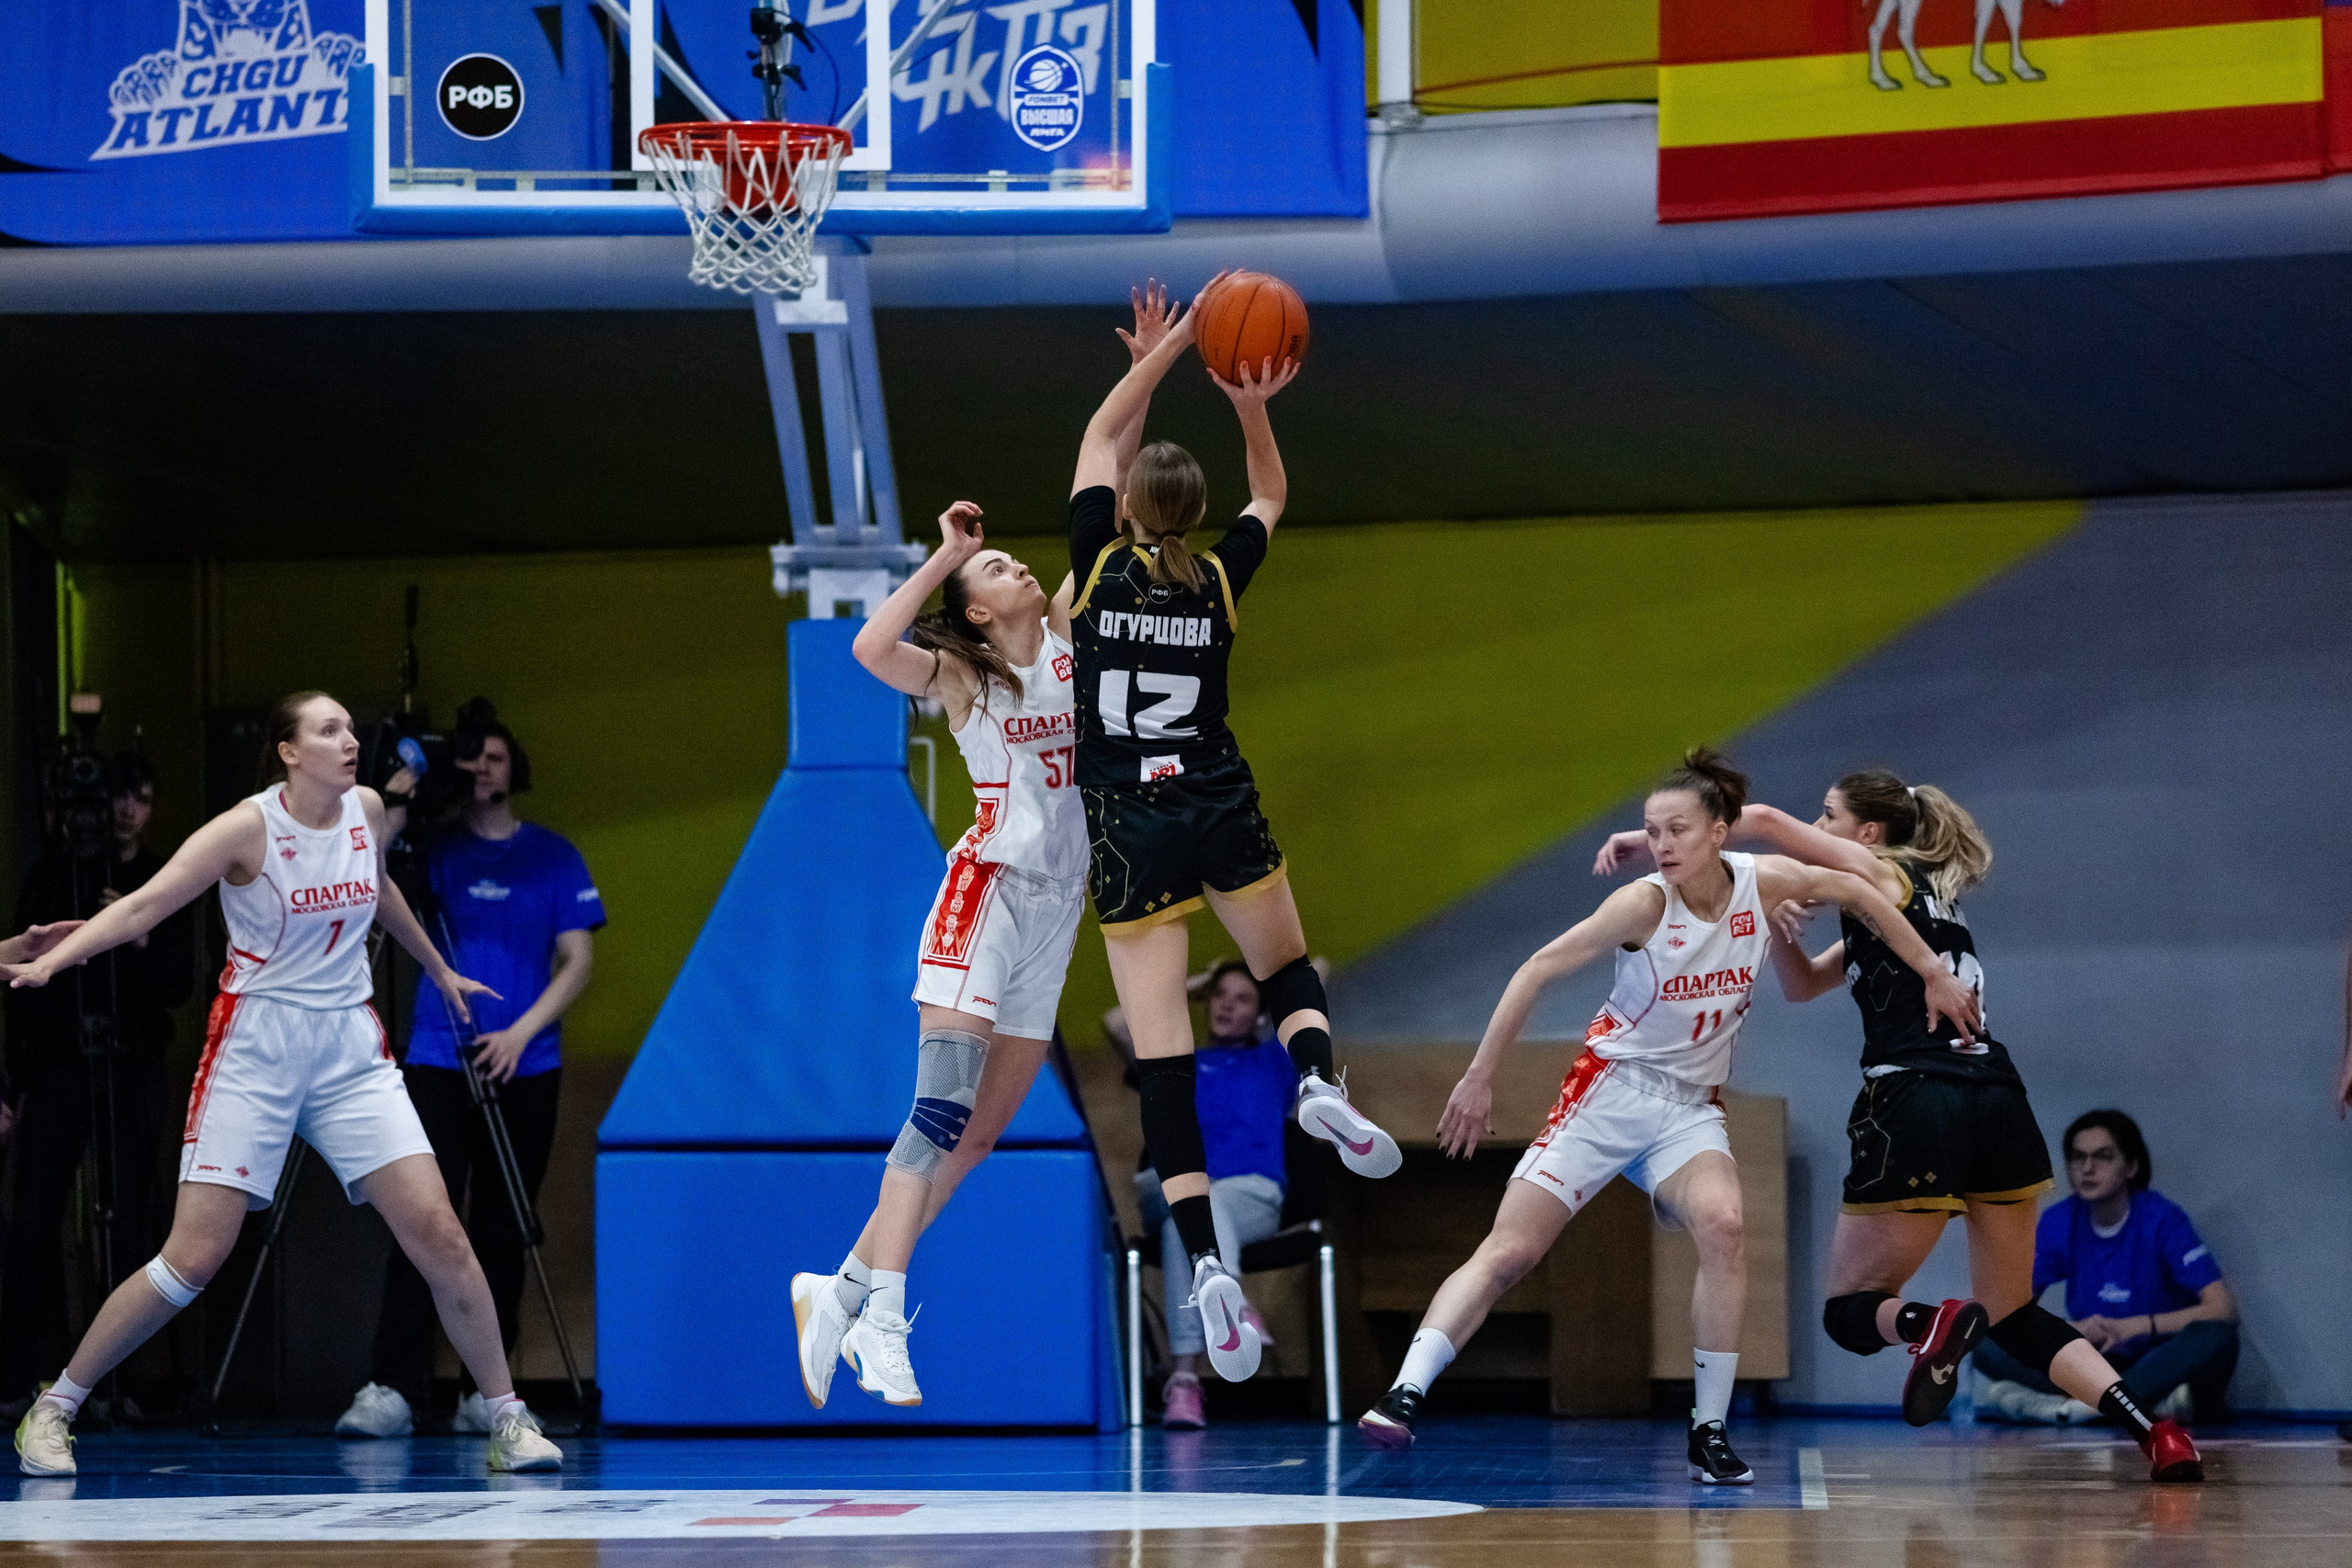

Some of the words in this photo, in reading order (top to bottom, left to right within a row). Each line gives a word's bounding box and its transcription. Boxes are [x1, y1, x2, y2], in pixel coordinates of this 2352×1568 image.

[181, 54, 310, 99] CHGU
[448, 85, 514, 109] РФБ
[107, 88, 348, 150] ATLANT
[1021, 108, 1073, 125] ВЫСШАЯ
[1151, 589, 1169, 597] РФБ
[1099, 610, 1212, 647] ОГУРЦОВА
[1058, 665, 1072, 679] BE
[1098, 670, 1201, 739] 12
[1003, 712, 1075, 736] СПАРТ
[1006, 728, 1064, 745] МОСКОВСКАЯ
[1037, 744, 1075, 789] 57
[291, 878, 375, 907] СПАРТАК
[1732, 913, 1751, 926] FON
[1733, 922, 1752, 935] BET
[323, 919, 346, 956] 7
[1662, 965, 1754, 994] СПАРТАК
[1658, 989, 1715, 1002] МОСКОВСКАЯ
[1718, 985, 1751, 997] ОБЛАСТ
[1691, 1009, 1723, 1043] 11
